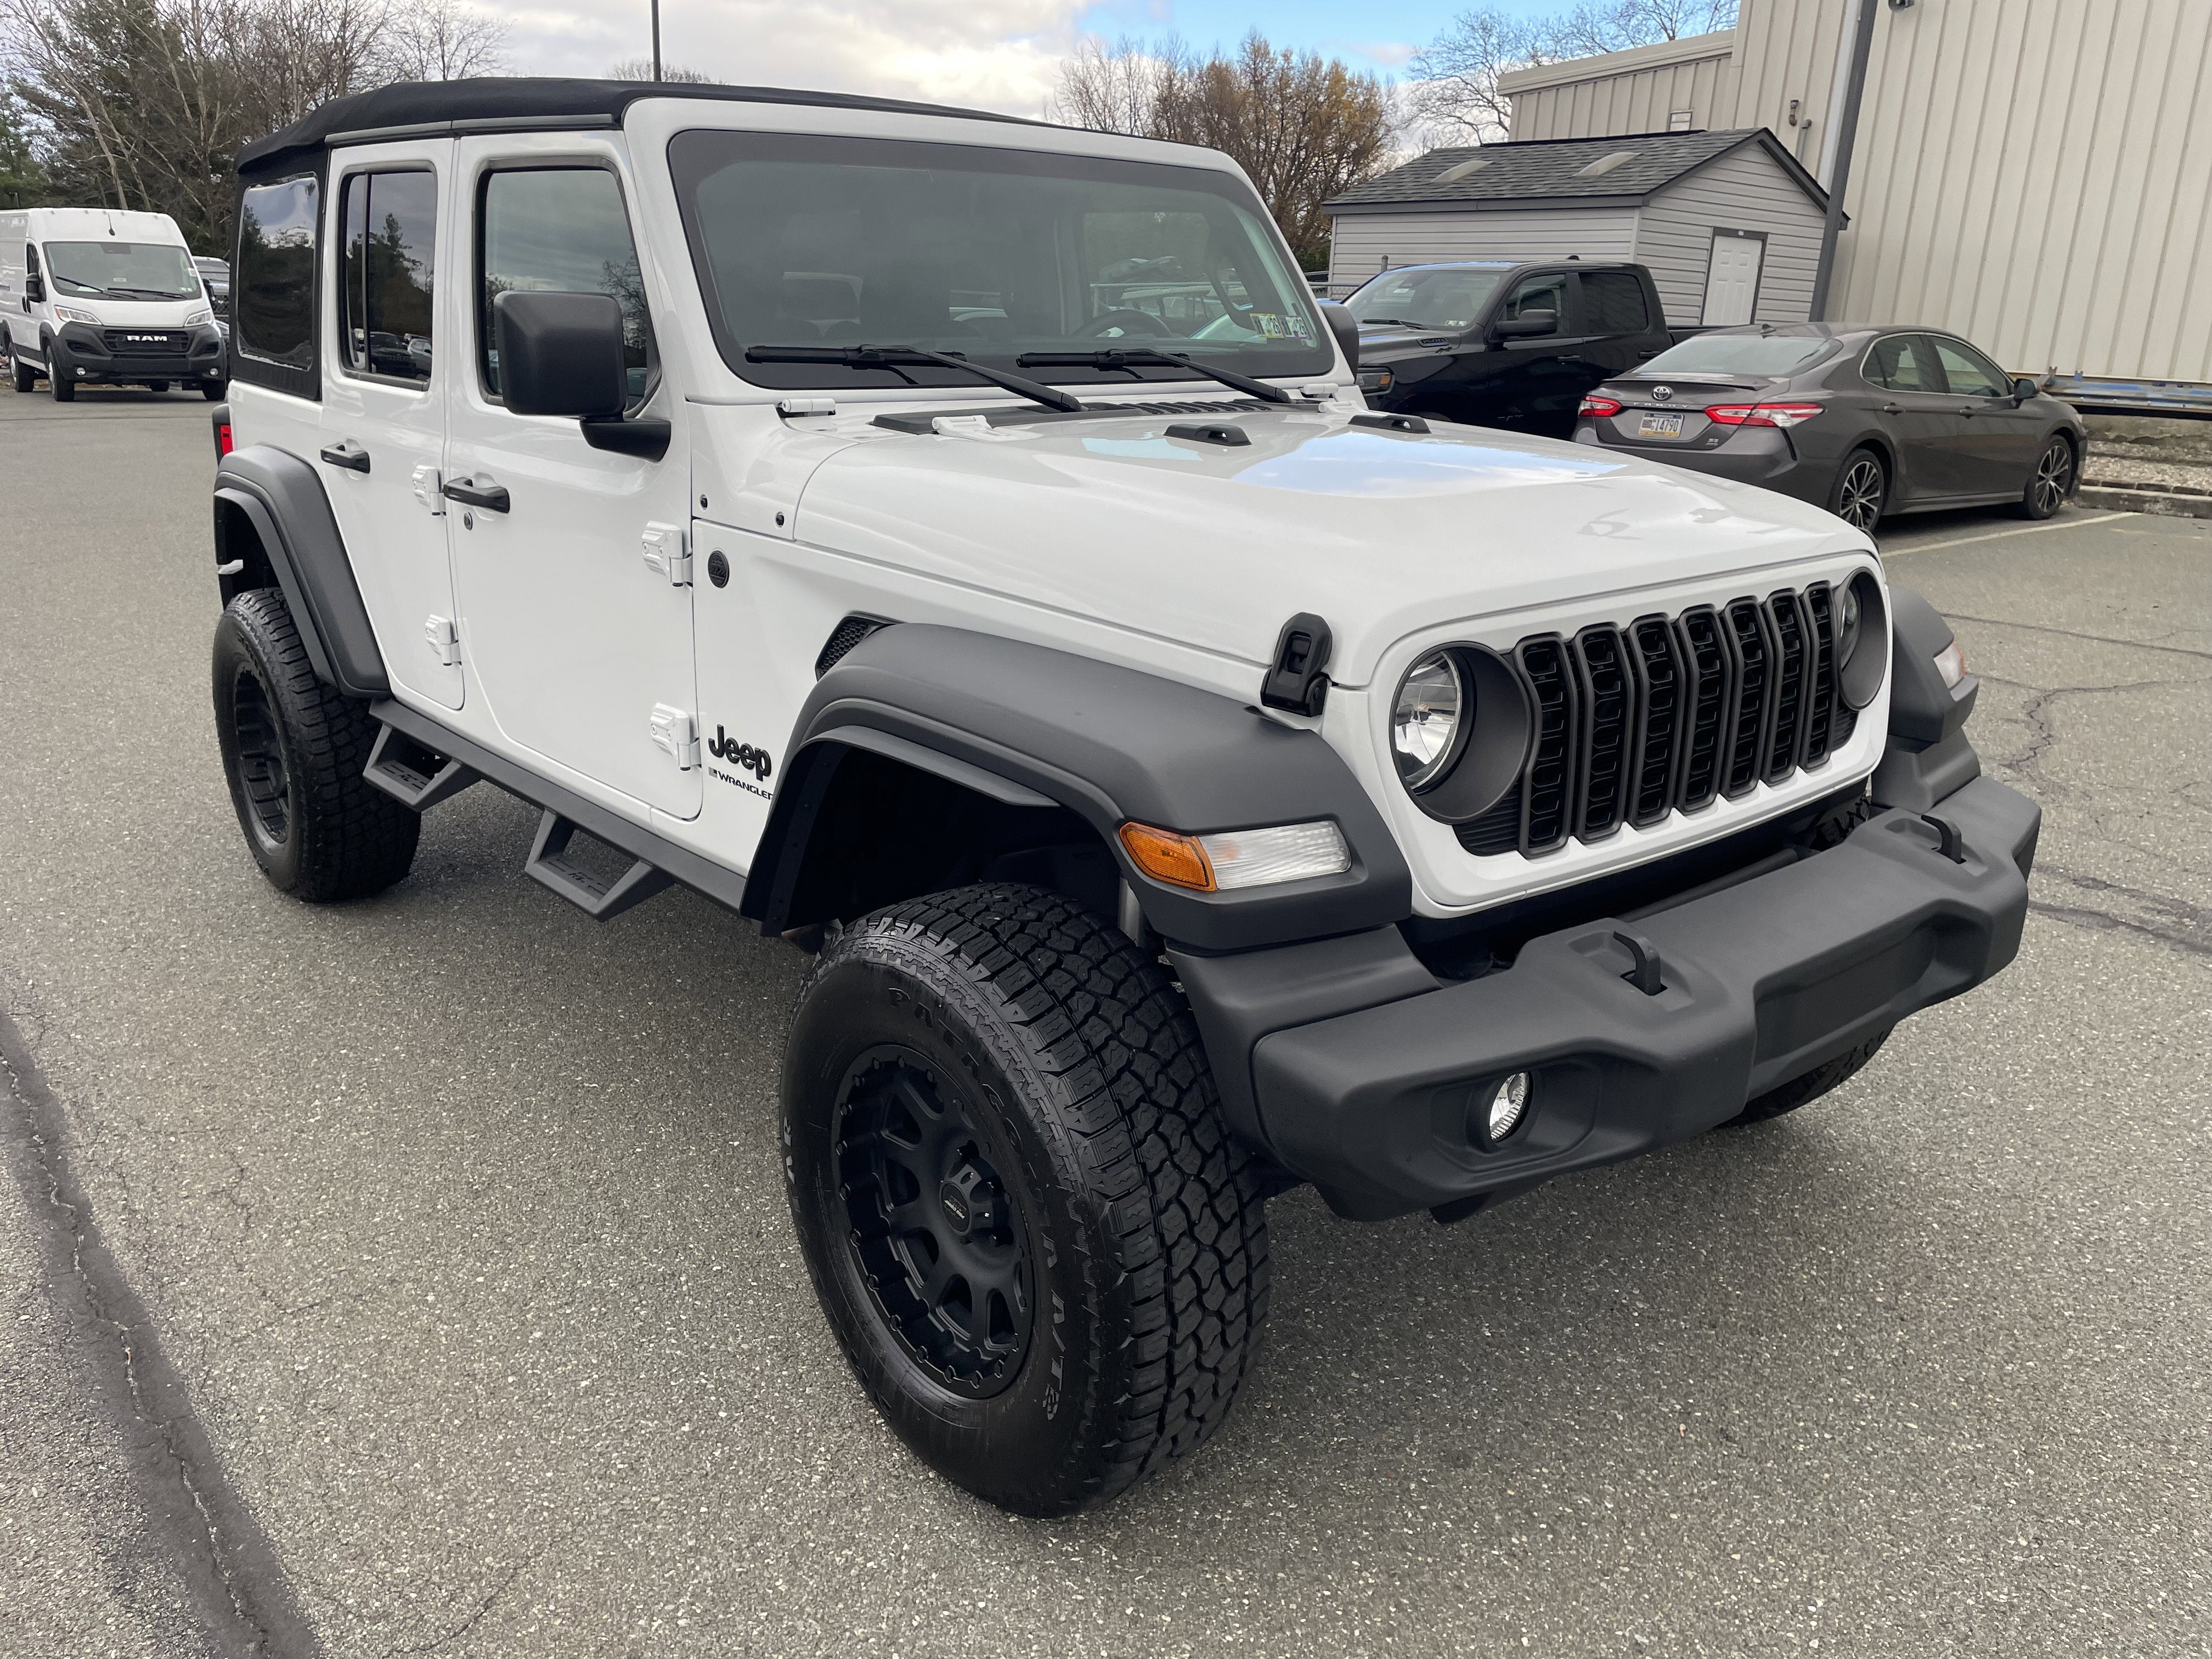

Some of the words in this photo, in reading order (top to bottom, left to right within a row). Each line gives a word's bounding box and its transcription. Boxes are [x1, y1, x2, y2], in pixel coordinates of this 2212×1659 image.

[1269, 318, 1281, 334] 26
[1296, 319, 1307, 335] 26
[1655, 419, 1679, 432] 14790
[708, 724, 772, 782] Jeep
